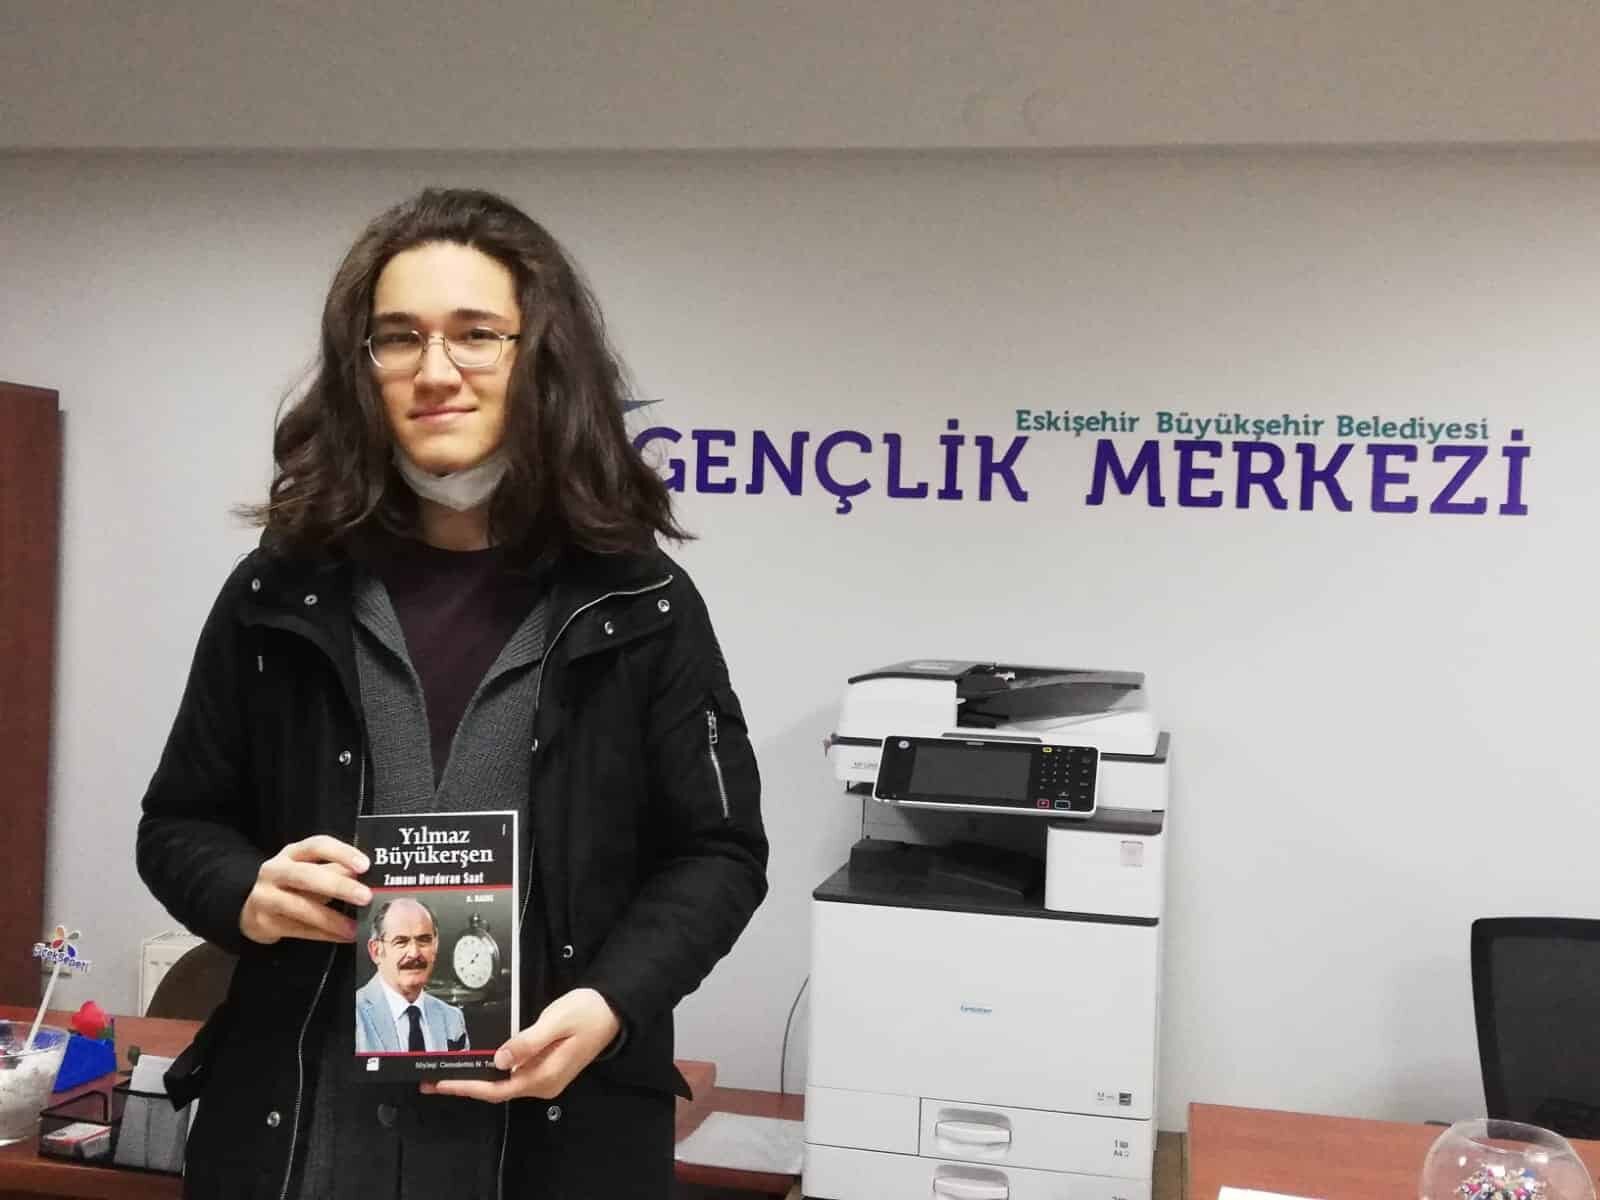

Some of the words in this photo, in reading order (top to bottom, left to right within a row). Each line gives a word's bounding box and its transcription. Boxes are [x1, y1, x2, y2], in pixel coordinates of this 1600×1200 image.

[1015, 409, 1140, 437] Eskişehir
[1156, 411, 1325, 441] Büyükşehir
[1336, 414, 1489, 444] Belediyesi
[632, 418, 1030, 515] GENÇLİK
[1085, 429, 1531, 516] MERKEZİ
[398, 825, 471, 845] Yılmaz
[374, 845, 495, 870] Büyükerşen
[463, 871, 485, 884] Saat
